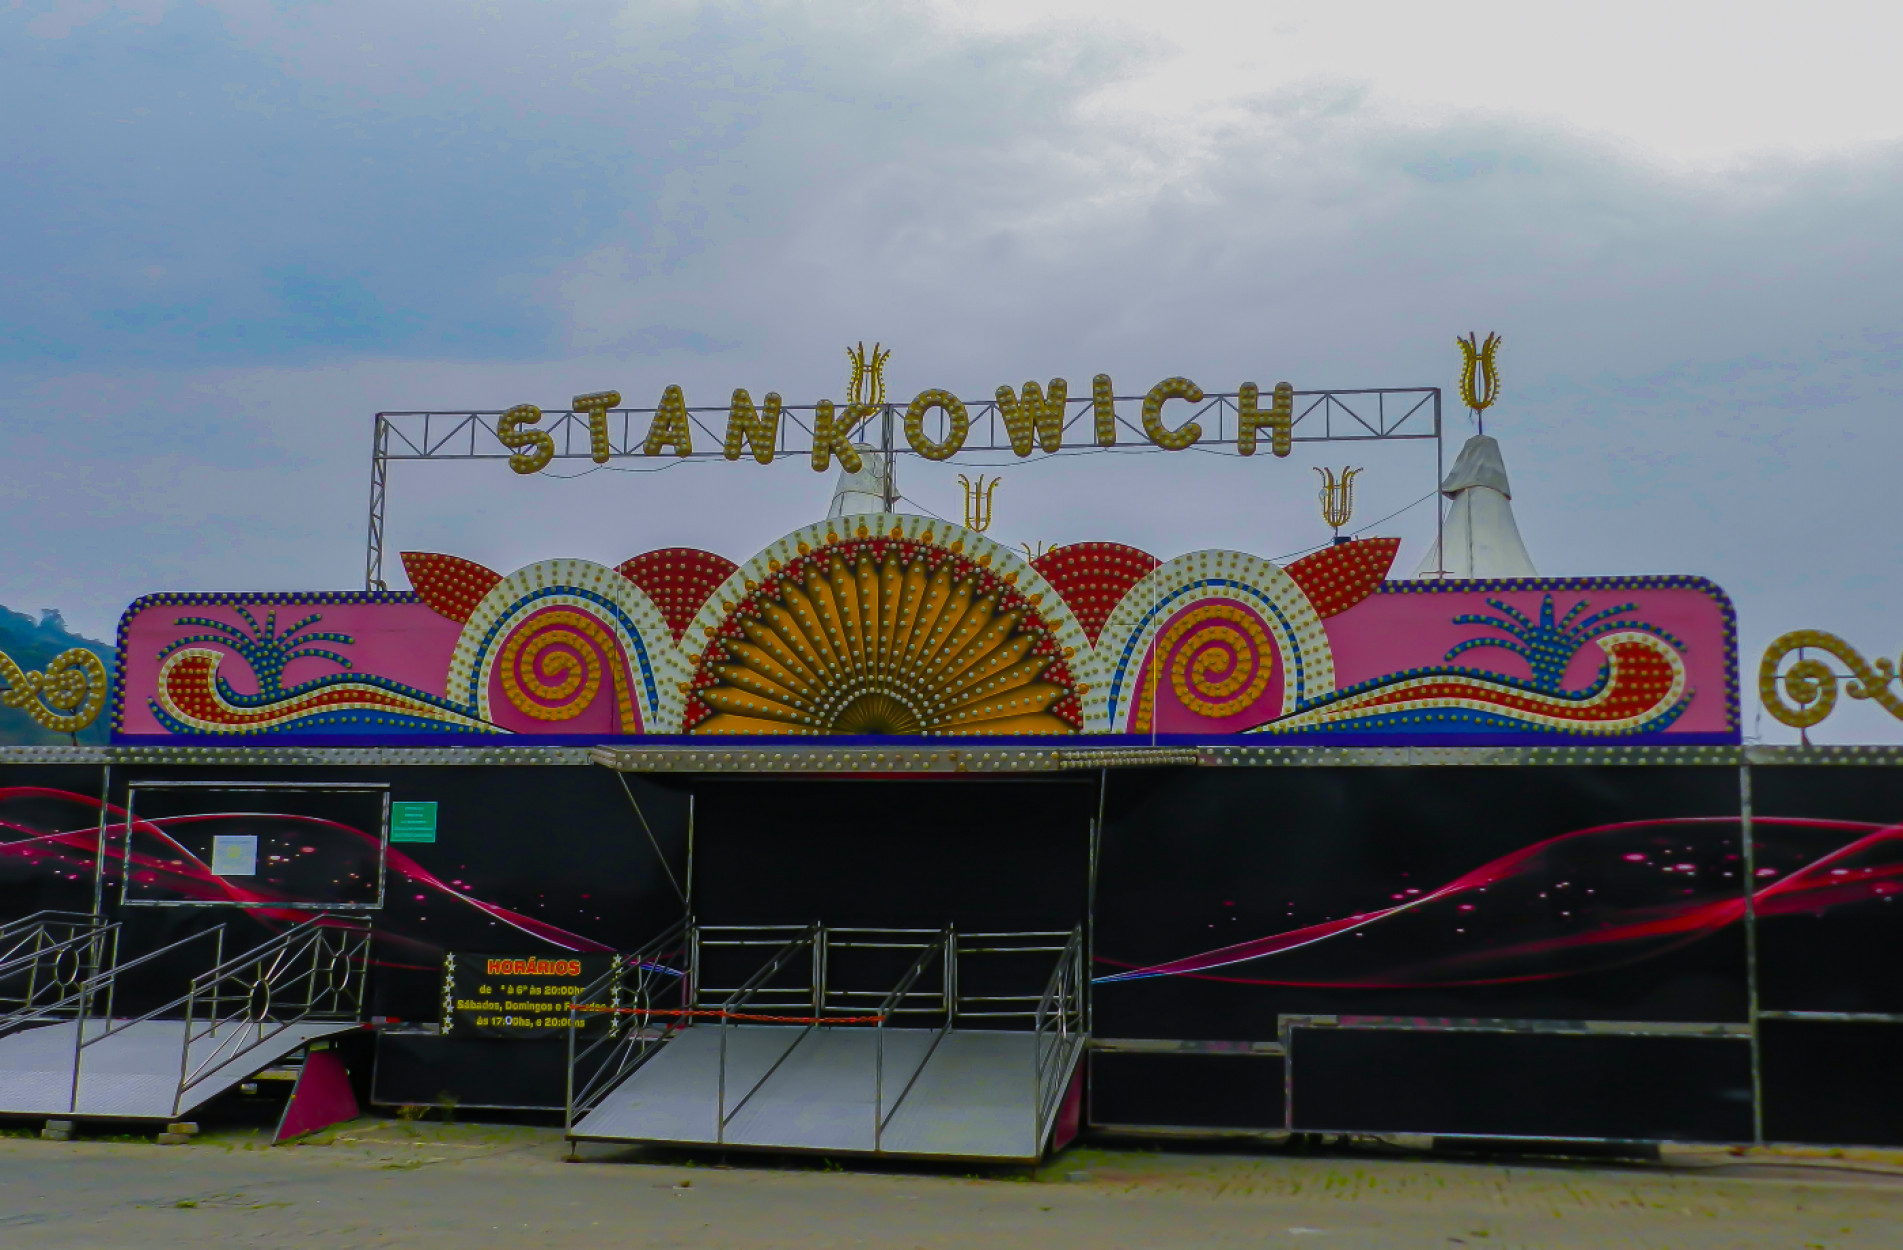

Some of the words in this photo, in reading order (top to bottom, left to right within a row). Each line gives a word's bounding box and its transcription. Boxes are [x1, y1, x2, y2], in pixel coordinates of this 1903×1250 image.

[497, 374, 1292, 475] STANKOWICH
[487, 956, 582, 975] HORÁRIOS
[479, 984, 493, 995] de
[505, 1000, 553, 1013] Domingos
